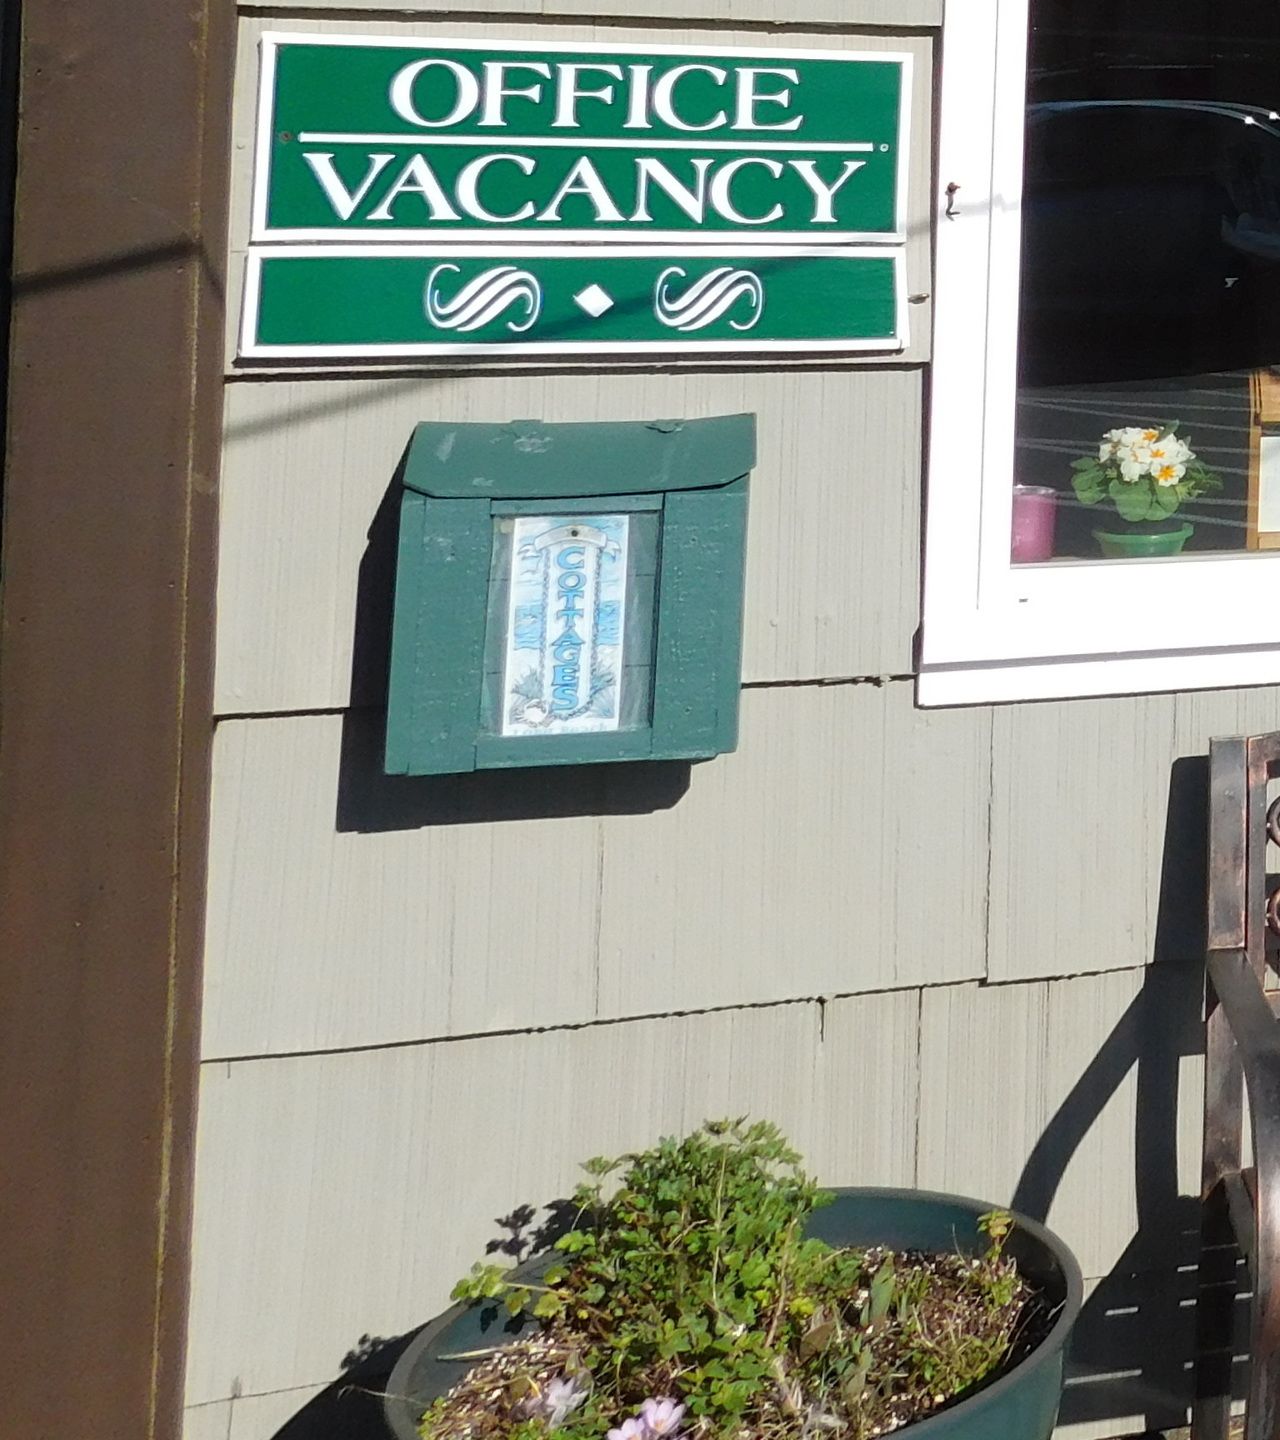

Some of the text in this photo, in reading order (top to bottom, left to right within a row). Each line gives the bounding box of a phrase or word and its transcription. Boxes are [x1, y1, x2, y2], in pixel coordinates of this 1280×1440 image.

[389, 58, 804, 131] OFFICE
[302, 153, 867, 224] VACANCY
[551, 545, 587, 711] COTTAGES
